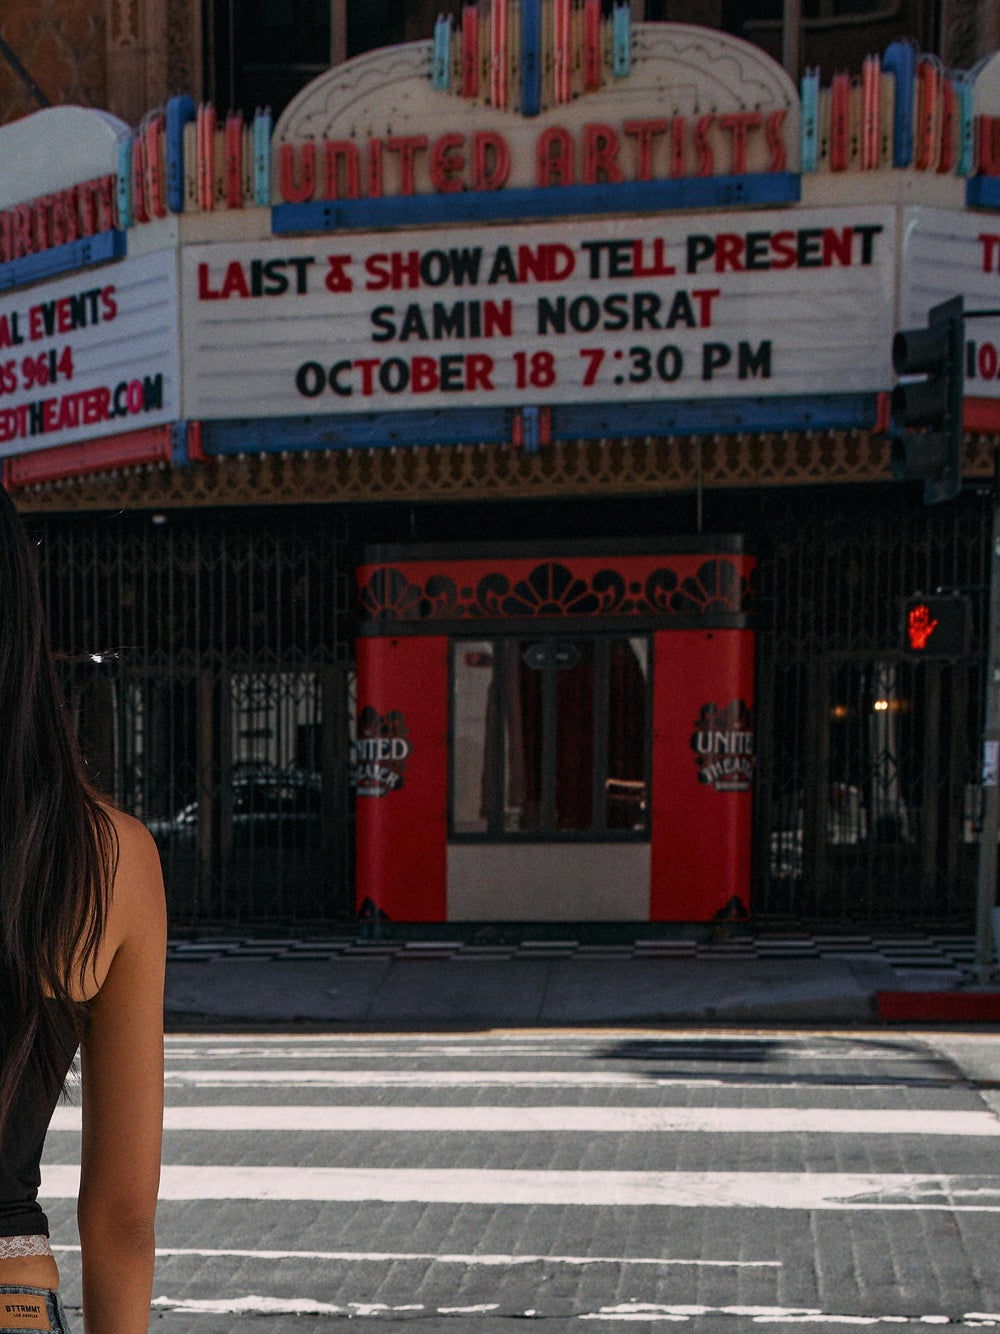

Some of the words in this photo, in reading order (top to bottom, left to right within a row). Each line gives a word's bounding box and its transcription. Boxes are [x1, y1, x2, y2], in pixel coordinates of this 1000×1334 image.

[278, 131, 511, 204] UNITED
[536, 110, 788, 187] ARTISTS
[198, 256, 315, 300] LAIST
[324, 255, 354, 293] &
[364, 246, 484, 291] SHOW
[487, 243, 577, 284] AND
[581, 237, 676, 280] TELL
[686, 224, 884, 275] PRESENT
[29, 284, 119, 342] EVENTS
[371, 299, 513, 343] SAMIN
[537, 288, 721, 335] NOSRAT
[22, 344, 75, 391] 9614
[295, 353, 495, 398] OCTOBER
[512, 350, 557, 390] 18
[579, 344, 685, 387] 7:30
[701, 339, 773, 381] PM
